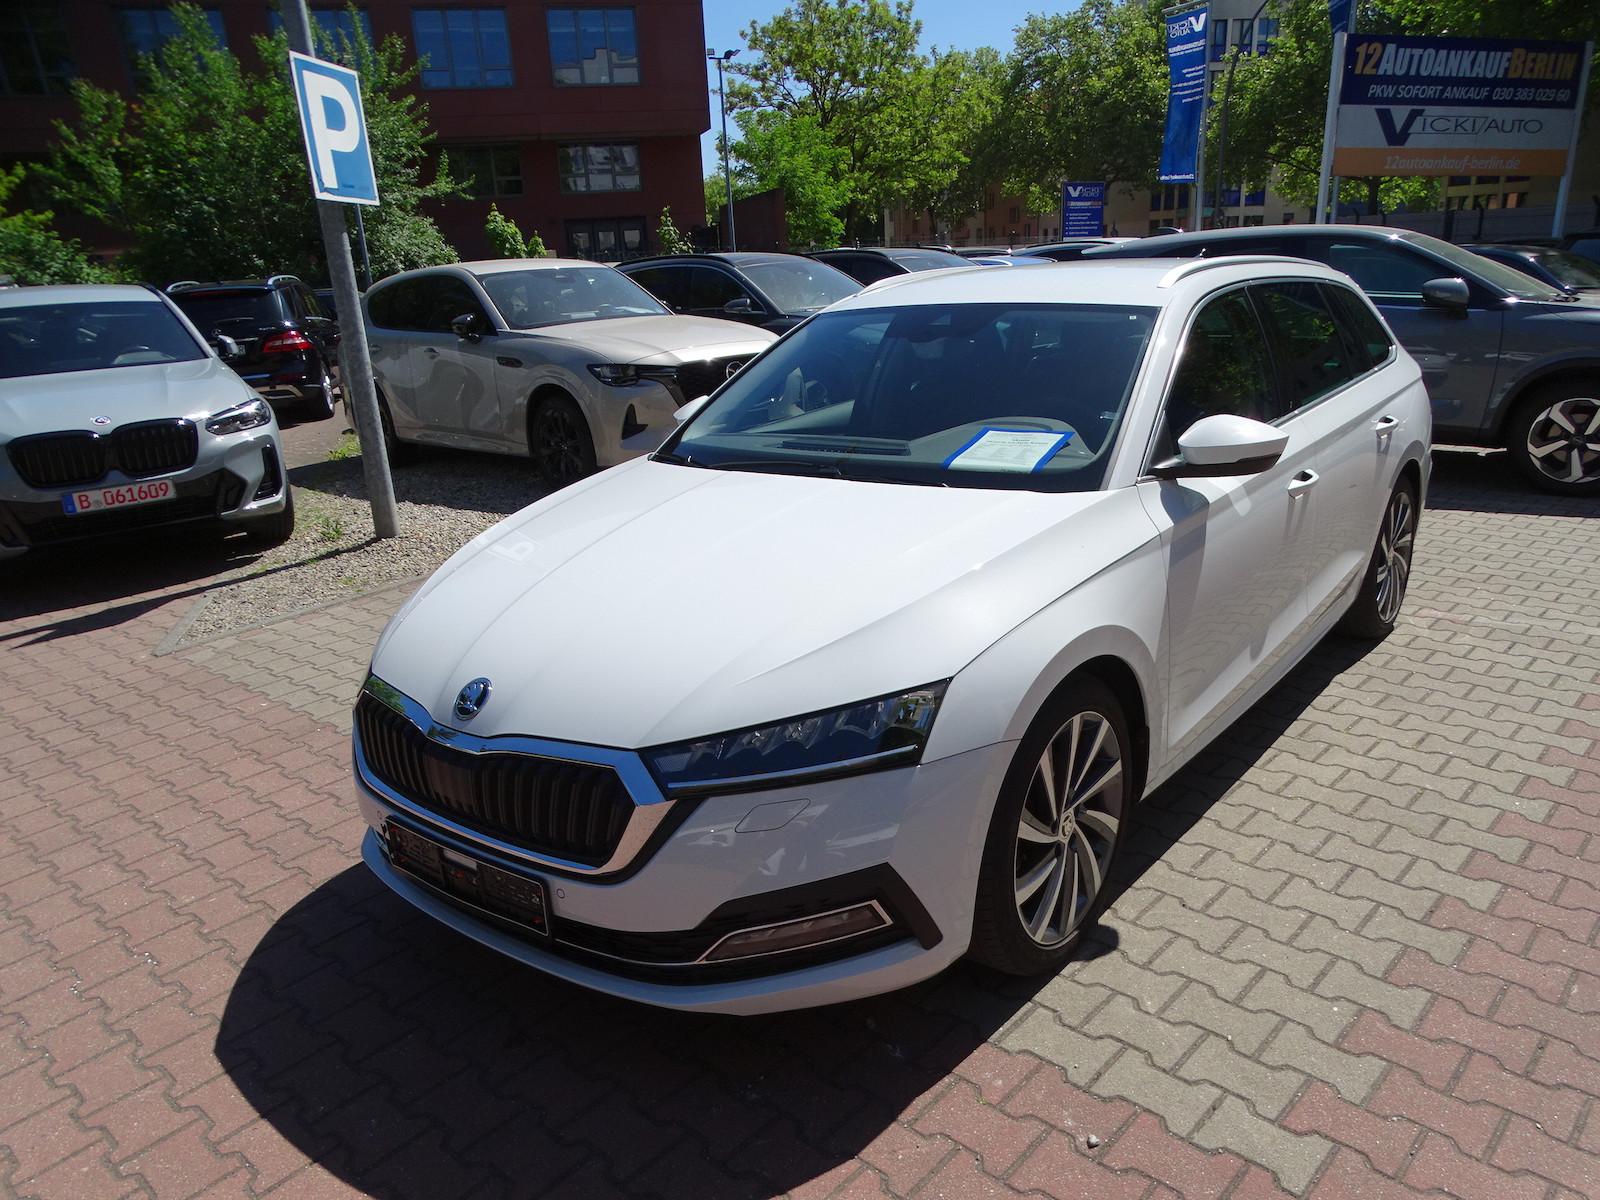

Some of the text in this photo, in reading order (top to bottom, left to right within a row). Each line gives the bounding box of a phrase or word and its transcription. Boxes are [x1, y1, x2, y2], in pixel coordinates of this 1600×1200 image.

[1367, 84, 1397, 98] PKW
[1397, 85, 1443, 99] SOFORT
[1442, 86, 1490, 100] ANKAUF
[1492, 87, 1513, 100] 030
[302, 70, 360, 189] P
[1384, 155, 1520, 172] 12autoankauf-berlin.de
[78, 481, 169, 510] B 061609
